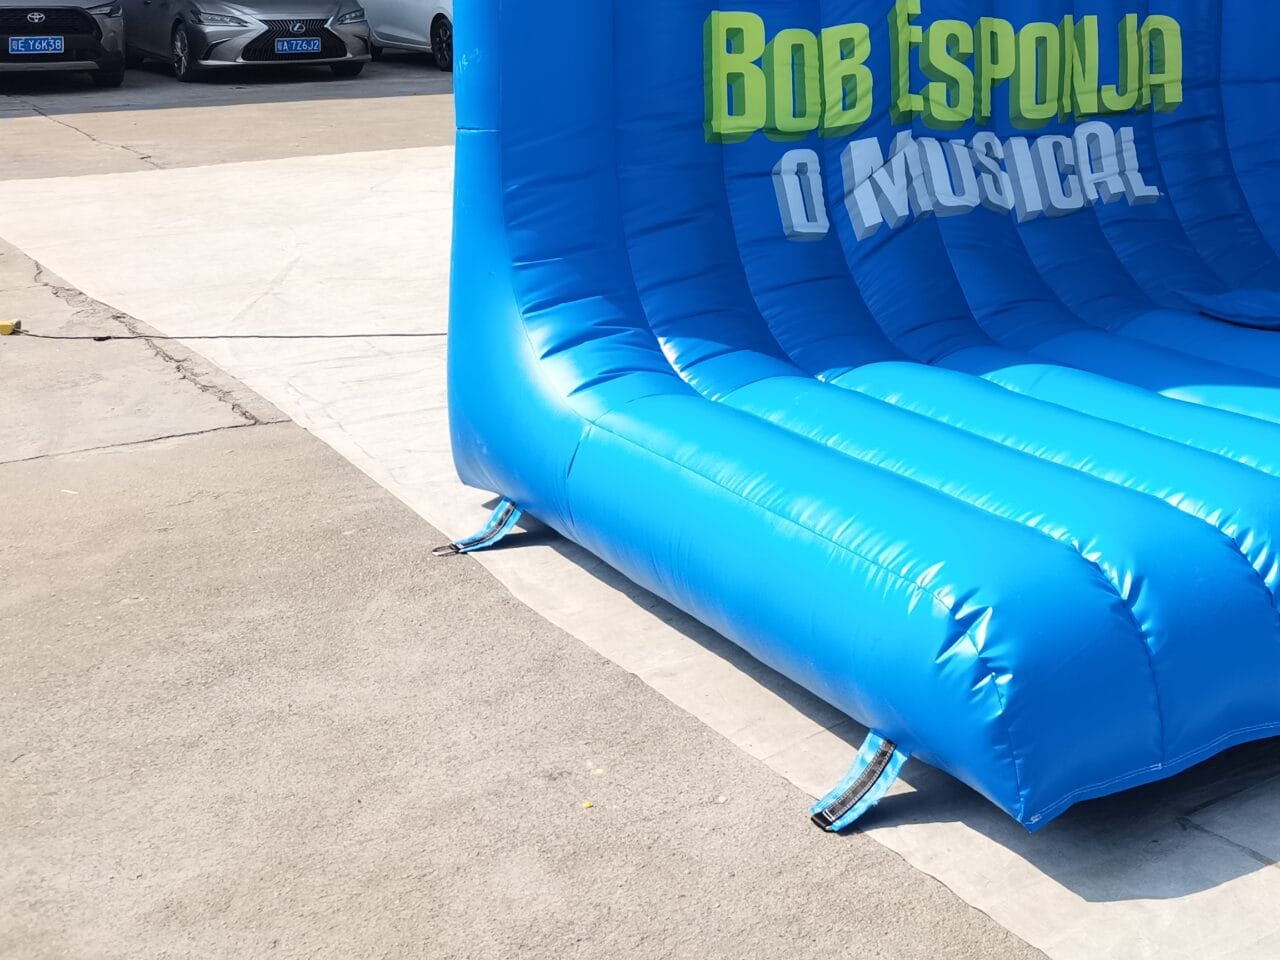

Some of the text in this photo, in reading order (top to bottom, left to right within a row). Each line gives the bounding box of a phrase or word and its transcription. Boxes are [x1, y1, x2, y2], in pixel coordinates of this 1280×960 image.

[704, 10, 872, 143] BOB
[772, 121, 1159, 241] O MUSICAL
